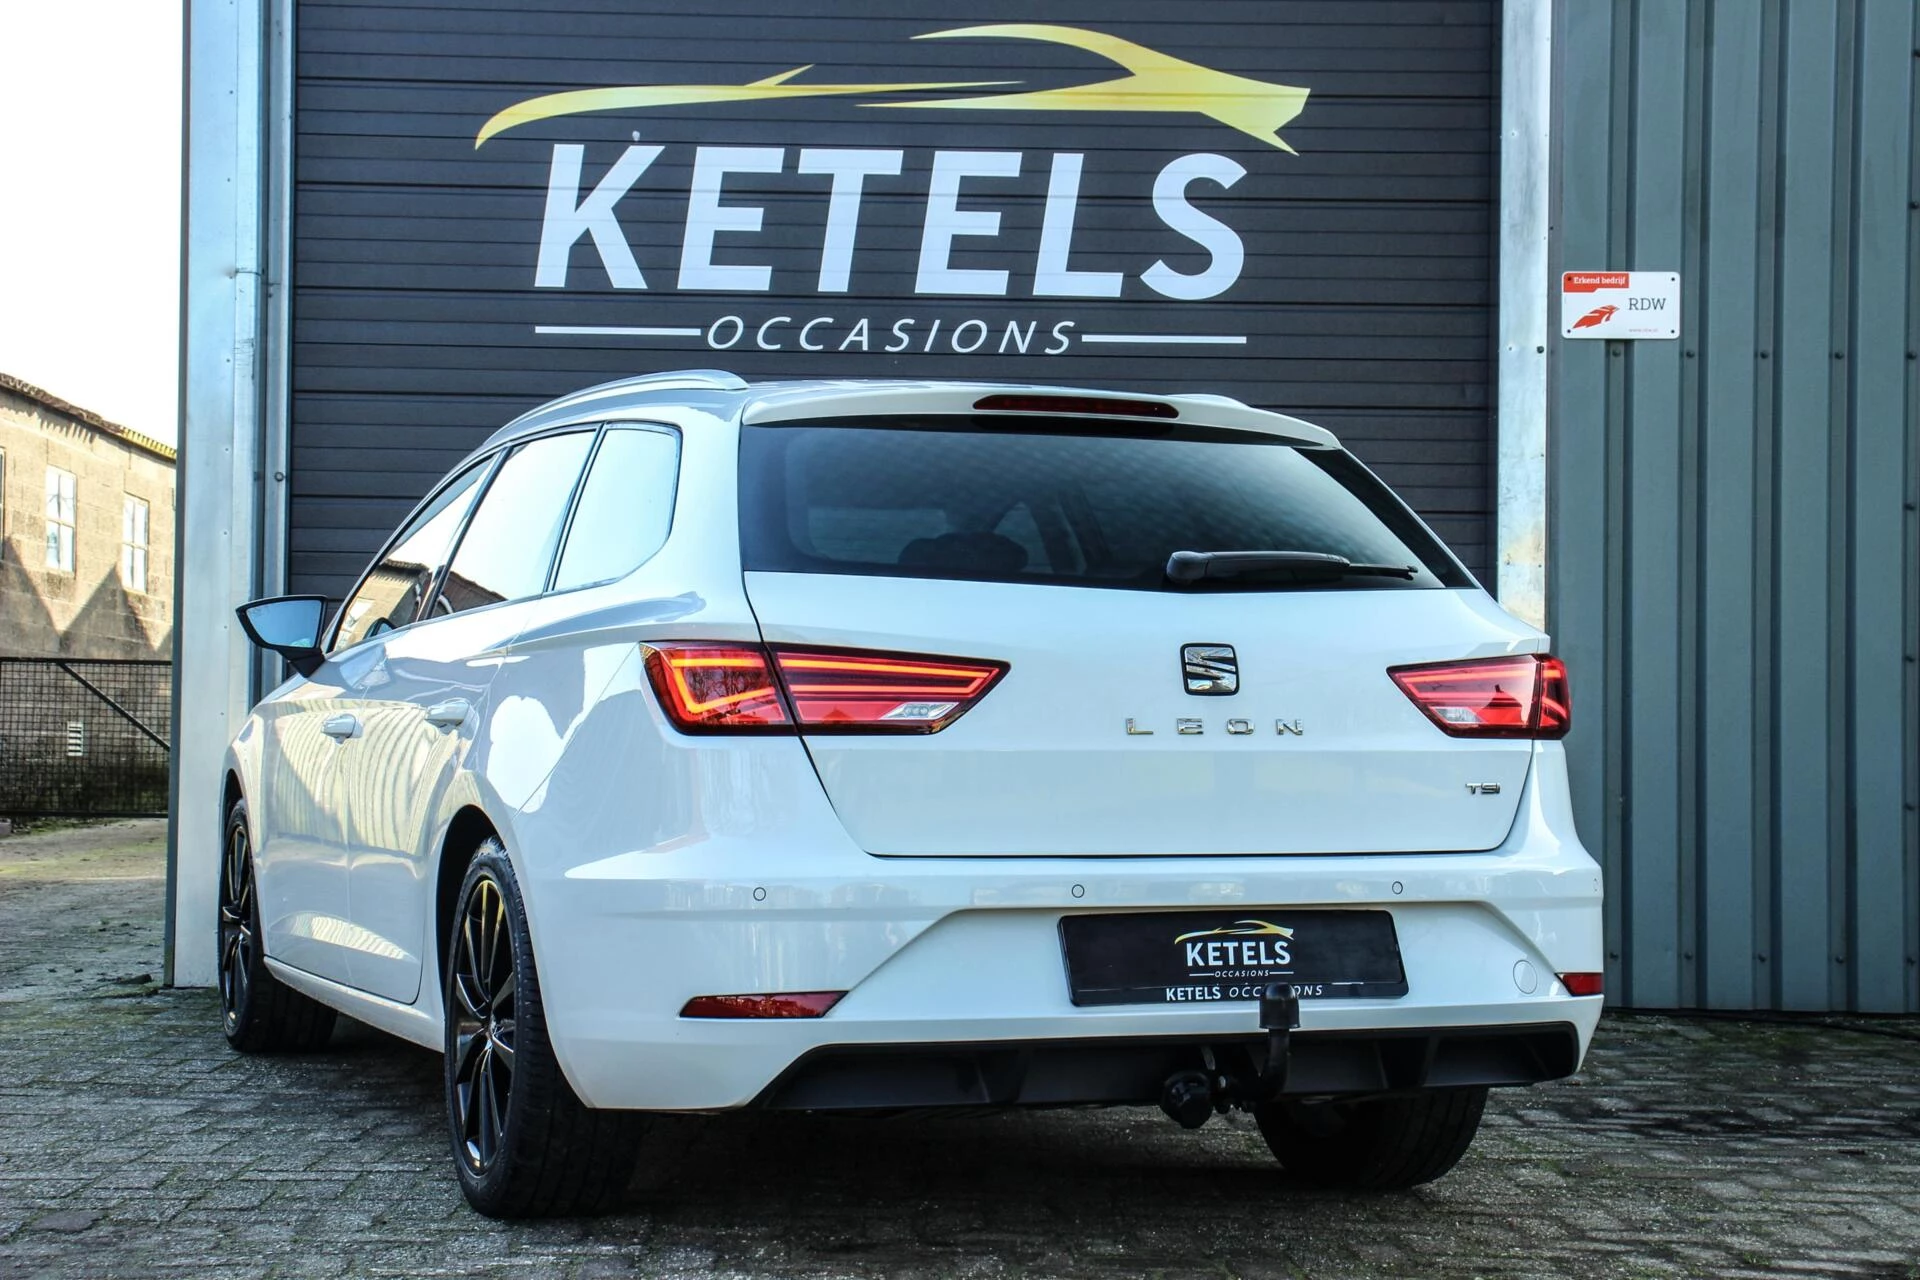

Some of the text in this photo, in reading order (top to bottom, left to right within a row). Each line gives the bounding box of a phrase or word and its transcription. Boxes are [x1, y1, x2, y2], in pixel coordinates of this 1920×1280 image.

[534, 143, 1248, 301] KETELS
[1573, 276, 1626, 286] Erkend bedrijf
[1628, 297, 1667, 311] RDW
[706, 315, 1075, 355] OCCASIONS
[1125, 717, 1304, 736] LEON
[1186, 941, 1291, 967] KETELS
[1214, 970, 1269, 978] OCCASIONS
[1166, 985, 1323, 1001] KETELS OCCONS
